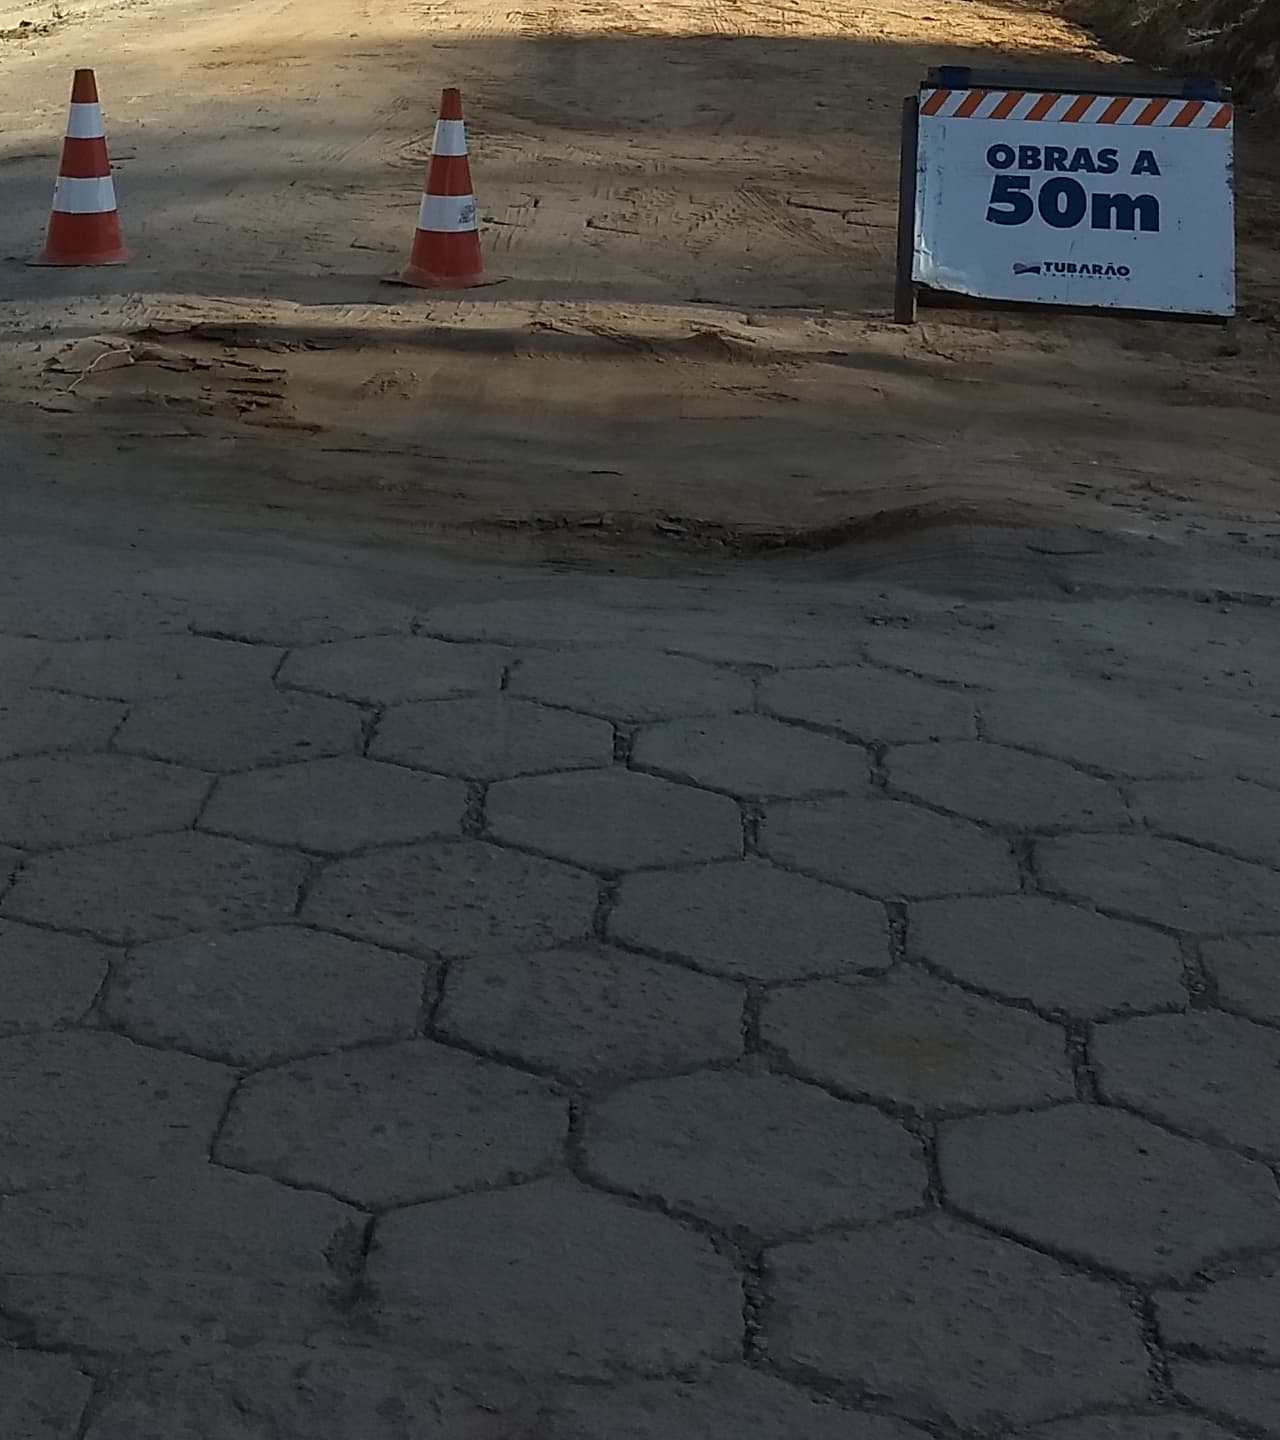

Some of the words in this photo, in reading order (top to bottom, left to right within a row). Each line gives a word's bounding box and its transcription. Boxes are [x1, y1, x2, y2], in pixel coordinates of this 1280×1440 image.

[985, 143, 1120, 175] OBRAS
[1130, 149, 1162, 177] A
[985, 174, 1161, 233] 50m
[1043, 261, 1131, 277] TUBARÃO
